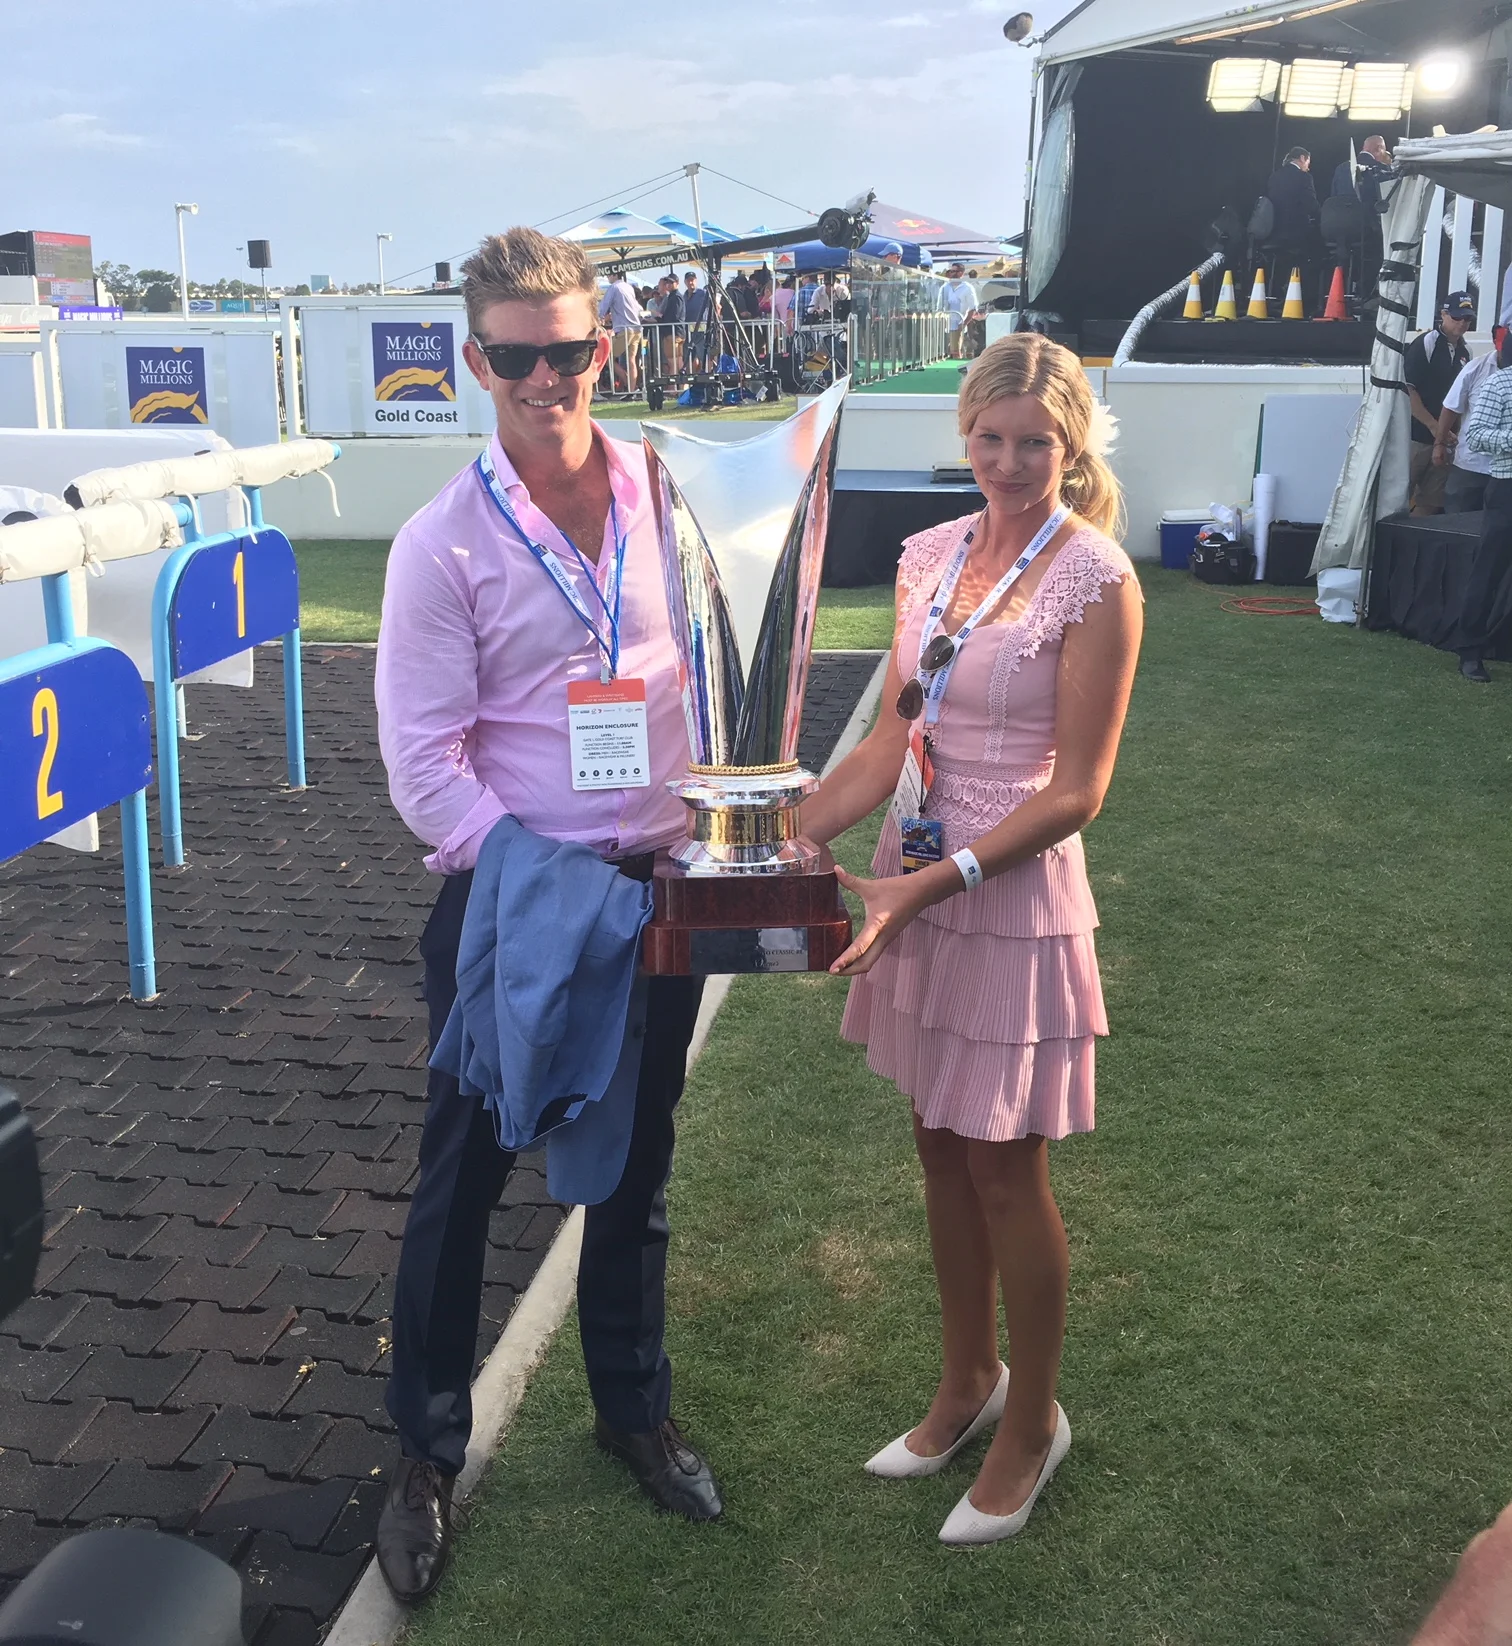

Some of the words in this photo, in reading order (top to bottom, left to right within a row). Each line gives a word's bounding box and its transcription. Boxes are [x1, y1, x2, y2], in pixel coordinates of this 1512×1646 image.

[612, 252, 688, 273] CAMERAS.COM.AU
[386, 336, 442, 350] MAGIC
[386, 351, 442, 361] MILLIONS
[139, 360, 193, 374] MAGIC
[140, 375, 193, 384] MILLIONS
[375, 409, 410, 422] Gold
[414, 410, 458, 422] Coast
[1030, 522, 1055, 552] MILLIONS
[550, 562, 572, 592] MILLIONS
[233, 552, 246, 638] 1
[932, 668, 949, 701] MILLIONS
[32, 688, 63, 820] 2
